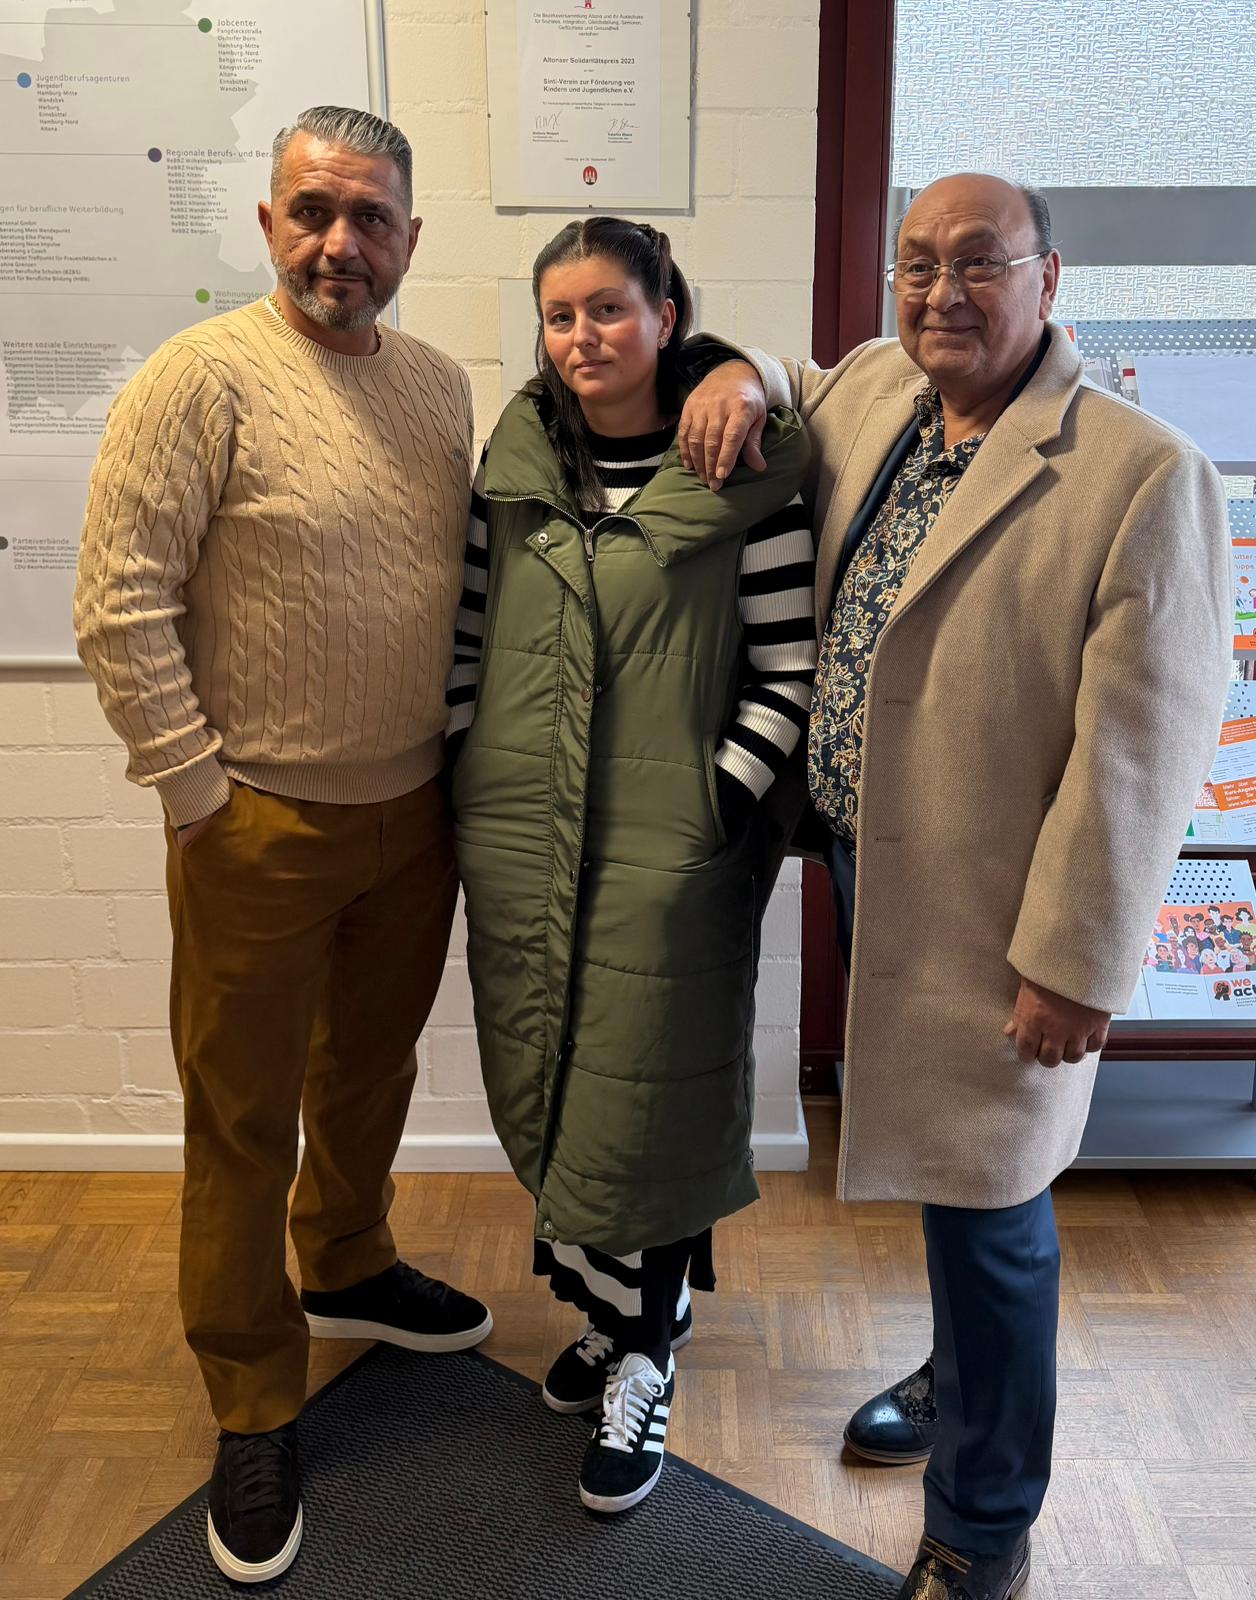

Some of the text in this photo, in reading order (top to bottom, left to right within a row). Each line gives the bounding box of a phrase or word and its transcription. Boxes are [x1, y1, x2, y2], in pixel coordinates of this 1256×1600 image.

[218, 18, 256, 27] Jobcenter
[570, 57, 619, 65] Solidaritätspreis
[36, 74, 130, 83] Jugendberufsagenturen
[591, 79, 622, 87] Förderung
[166, 149, 205, 157] Regionale
[208, 149, 236, 157] Berufs-
[17, 204, 27, 212] für
[30, 204, 67, 213] berufliche
[69, 205, 124, 215] Weiterbildung
[63, 342, 117, 350] Einrichtungen
[12, 537, 69, 545] Parteiverbände
[1231, 978, 1251, 988] we
